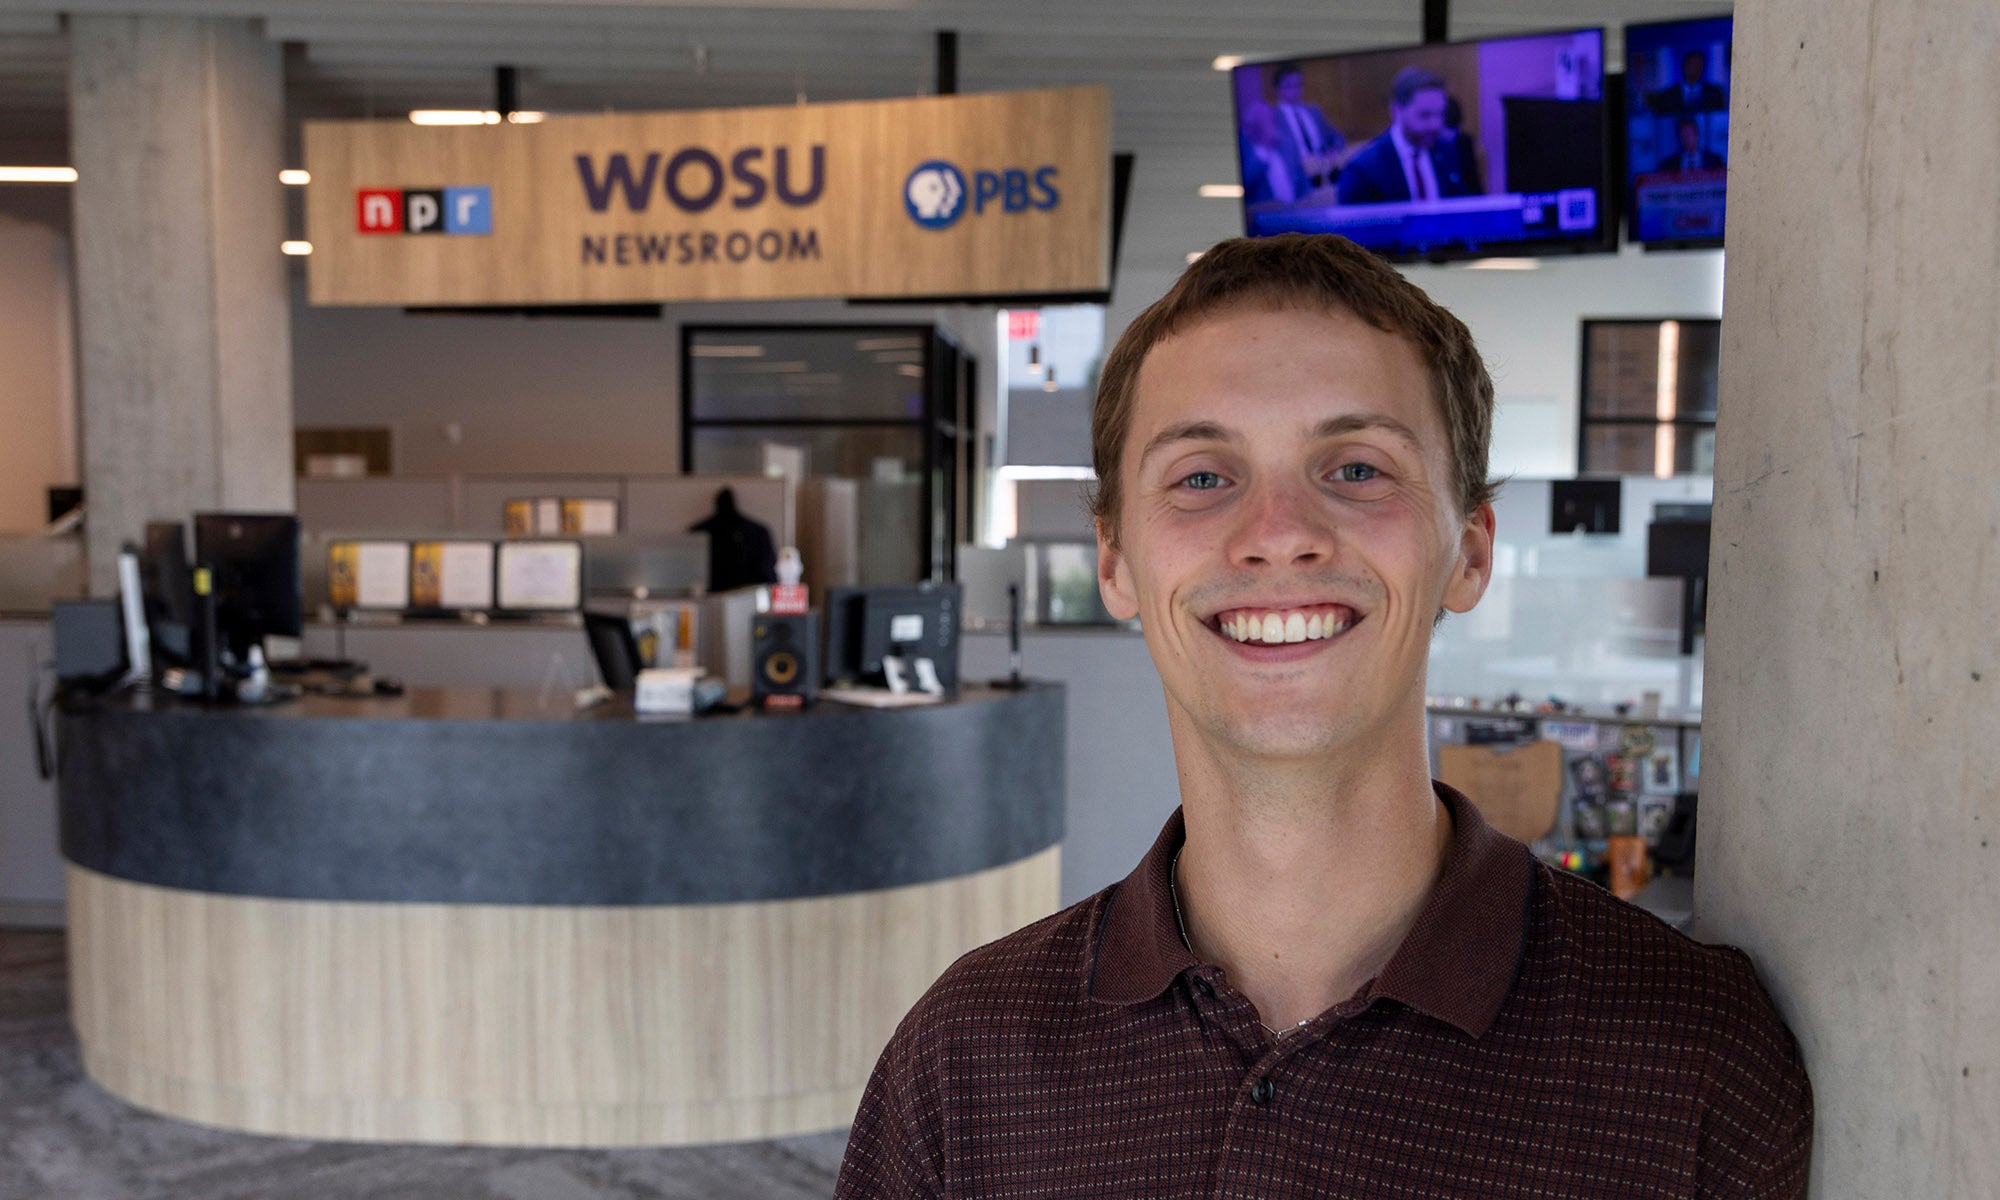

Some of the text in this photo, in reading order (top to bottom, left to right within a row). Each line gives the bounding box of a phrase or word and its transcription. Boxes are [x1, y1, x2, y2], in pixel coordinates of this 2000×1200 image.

[576, 145, 826, 214] WOSU
[974, 164, 1060, 214] PBS
[362, 193, 480, 233] npr
[582, 229, 820, 265] NEWSROOM
